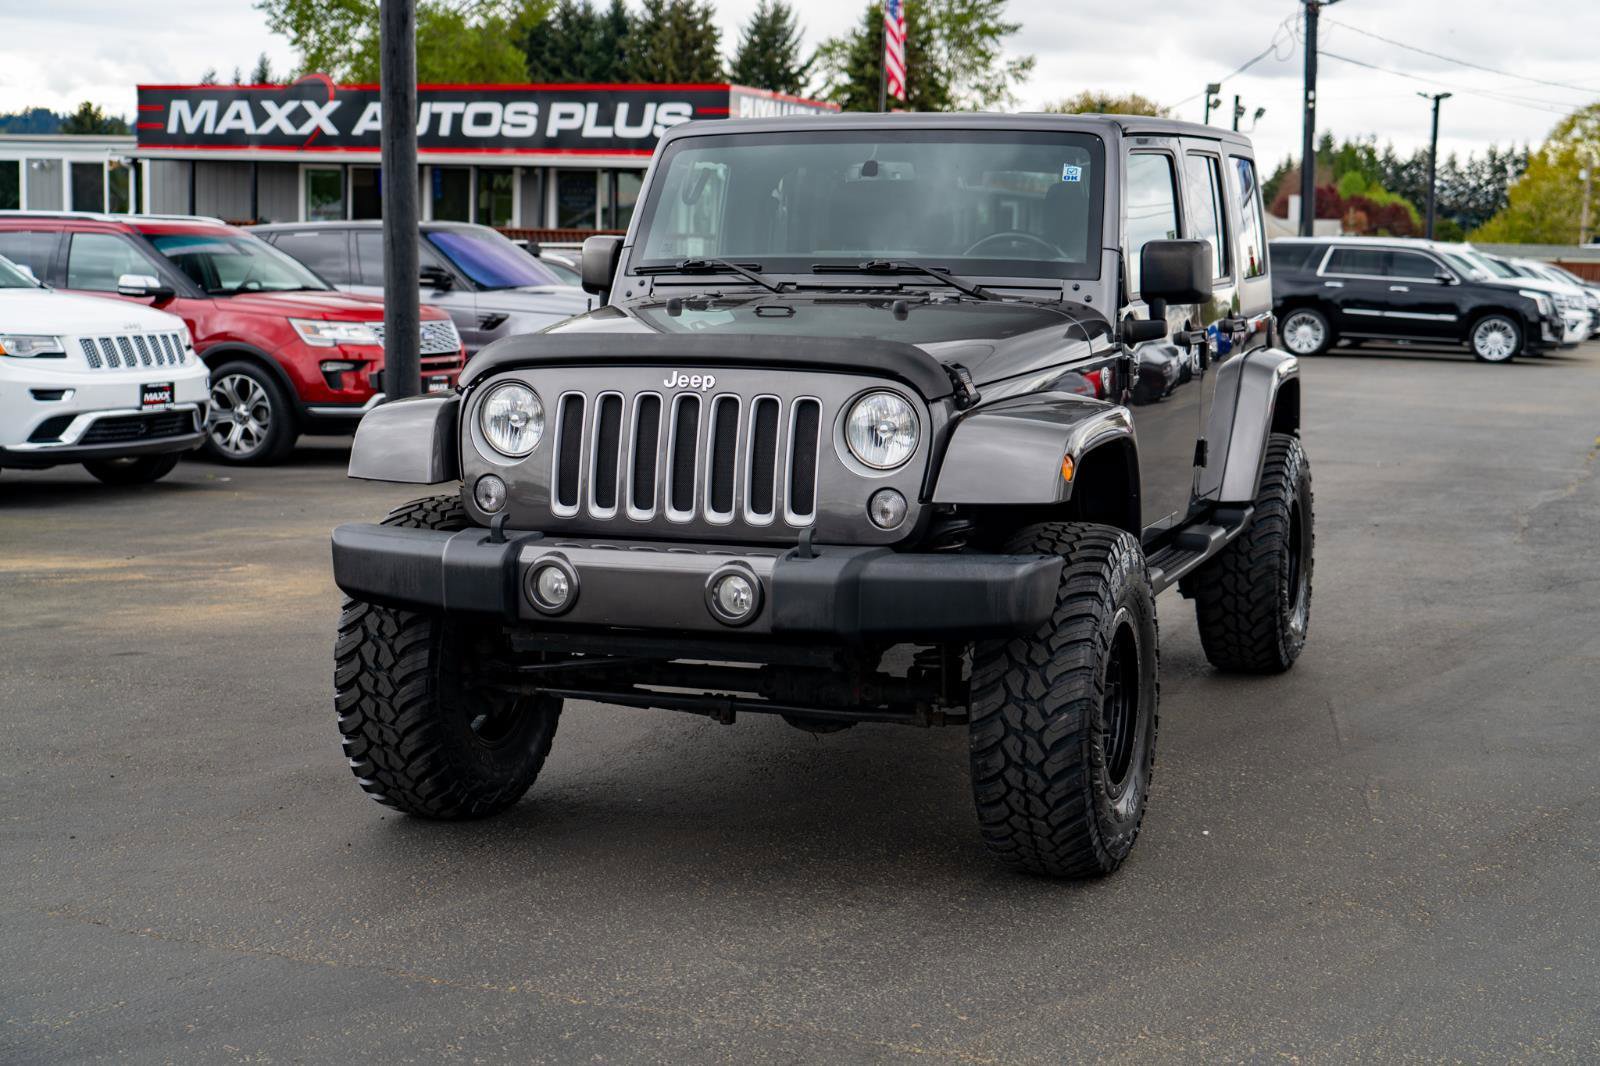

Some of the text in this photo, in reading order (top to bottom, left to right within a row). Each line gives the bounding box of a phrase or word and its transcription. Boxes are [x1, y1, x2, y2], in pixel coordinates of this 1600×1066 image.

[166, 99, 341, 136] MAXX
[545, 101, 693, 138] PLUS
[663, 370, 716, 392] Jeep
[143, 391, 171, 402] MAXX
